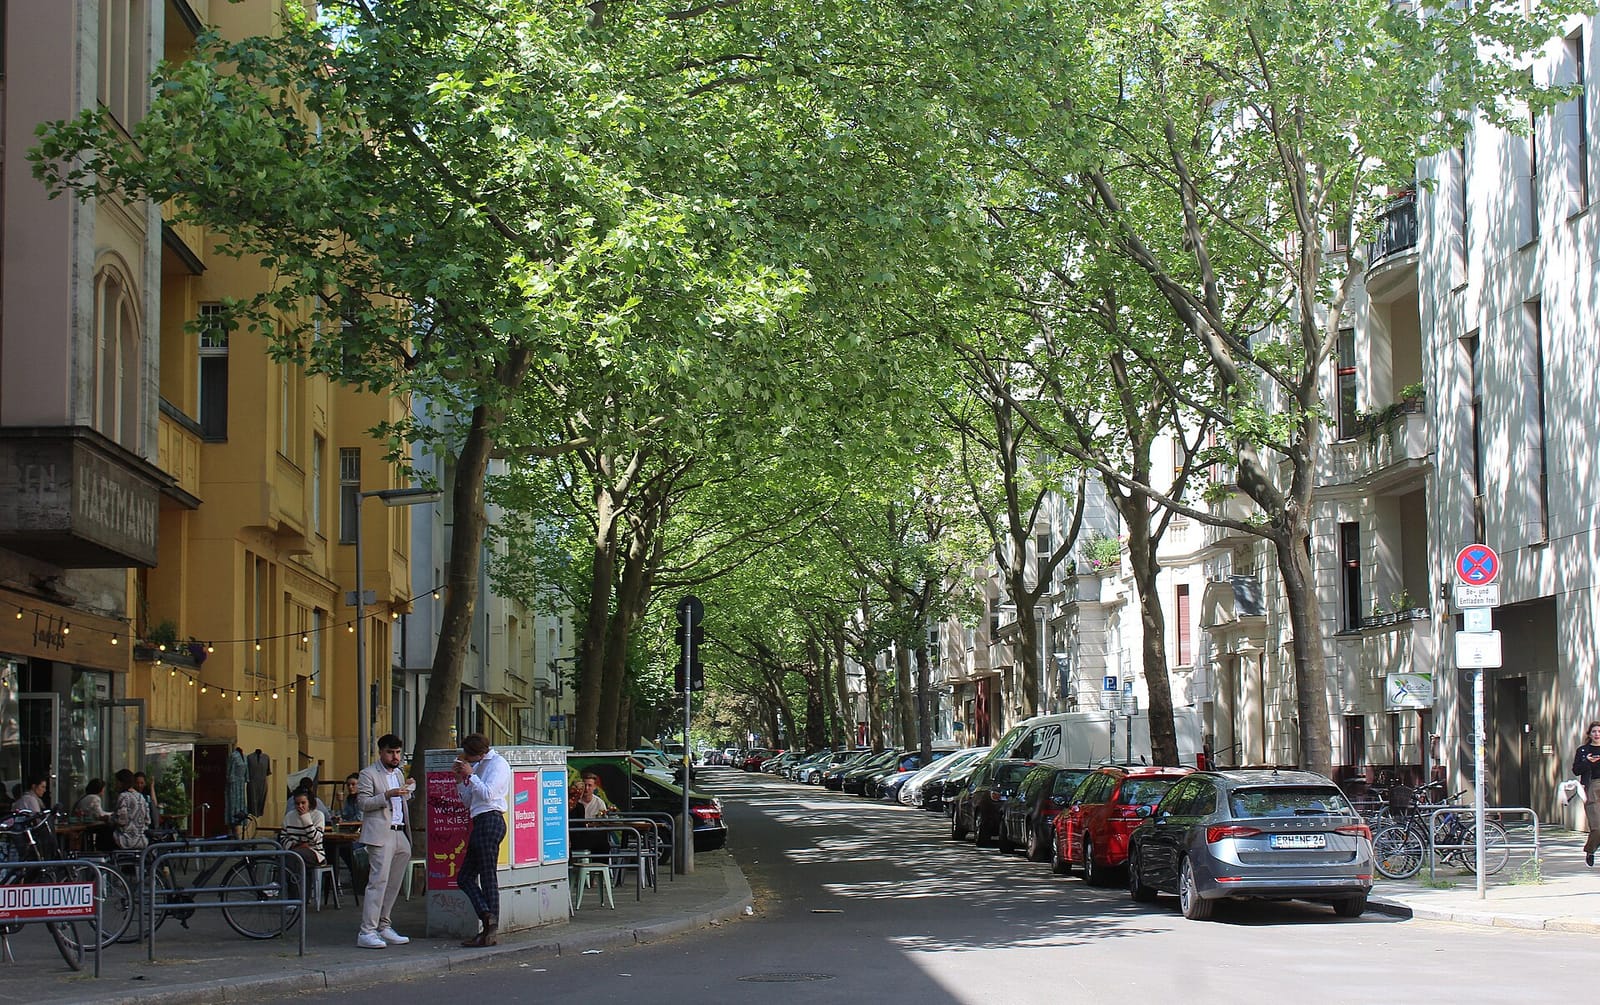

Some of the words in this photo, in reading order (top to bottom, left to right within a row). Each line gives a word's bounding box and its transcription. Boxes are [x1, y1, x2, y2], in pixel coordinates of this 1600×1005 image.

[79, 465, 154, 546] HARTMANN
[515, 810, 535, 821] Werbung
[1276, 835, 1294, 845] ERH
